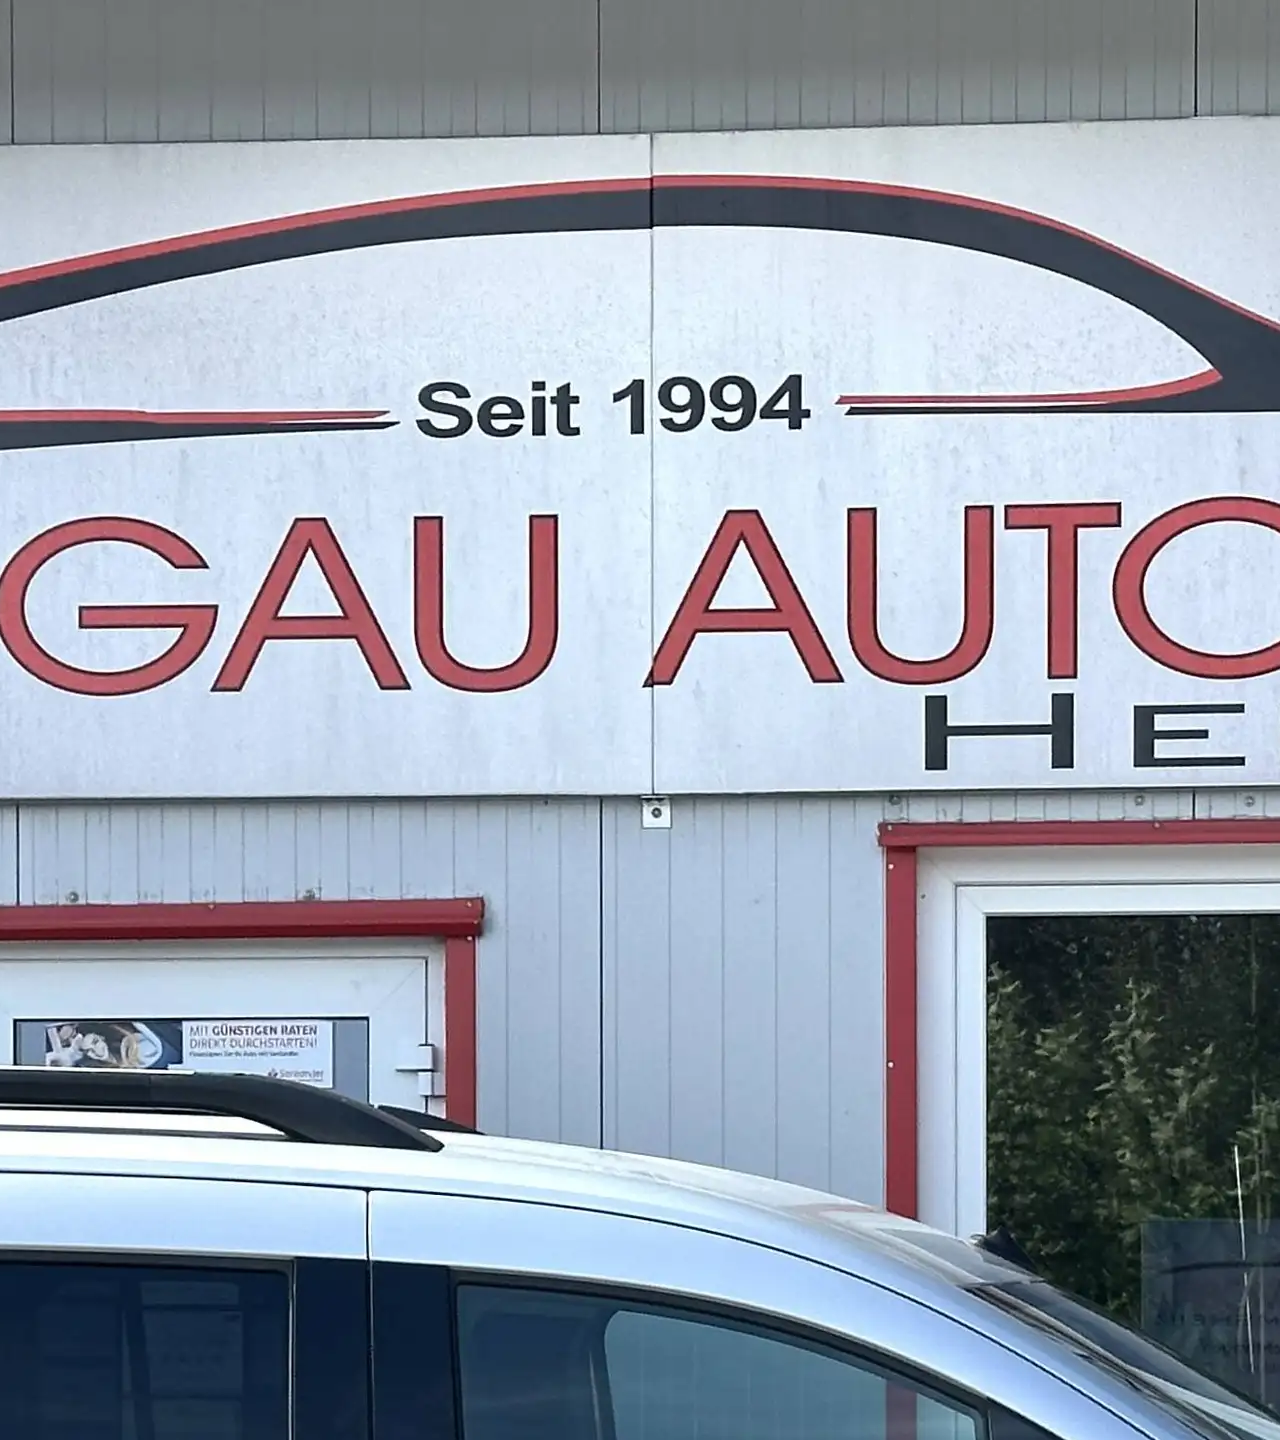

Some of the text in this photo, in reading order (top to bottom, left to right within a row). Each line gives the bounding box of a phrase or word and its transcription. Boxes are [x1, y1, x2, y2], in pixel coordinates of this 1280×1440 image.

[415, 373, 812, 439] Seit 1994
[189, 1023, 318, 1036] MIT GÜNSTIGEN RATEN
[189, 1038, 227, 1049] DIREKT
